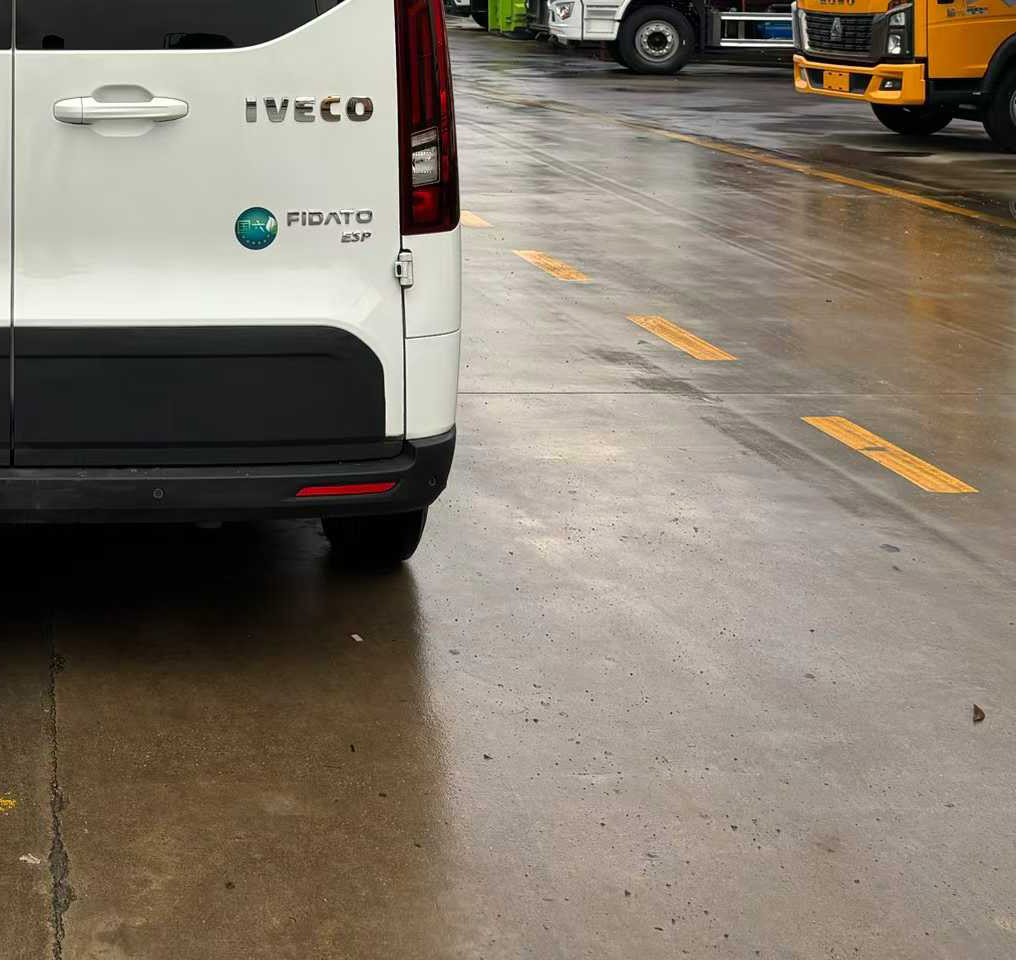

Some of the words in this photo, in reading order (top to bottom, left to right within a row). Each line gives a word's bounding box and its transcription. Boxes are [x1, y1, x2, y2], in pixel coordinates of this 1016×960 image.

[245, 96, 374, 123] IVECO
[287, 210, 373, 227] FIDATO
[340, 232, 372, 243] ESP
